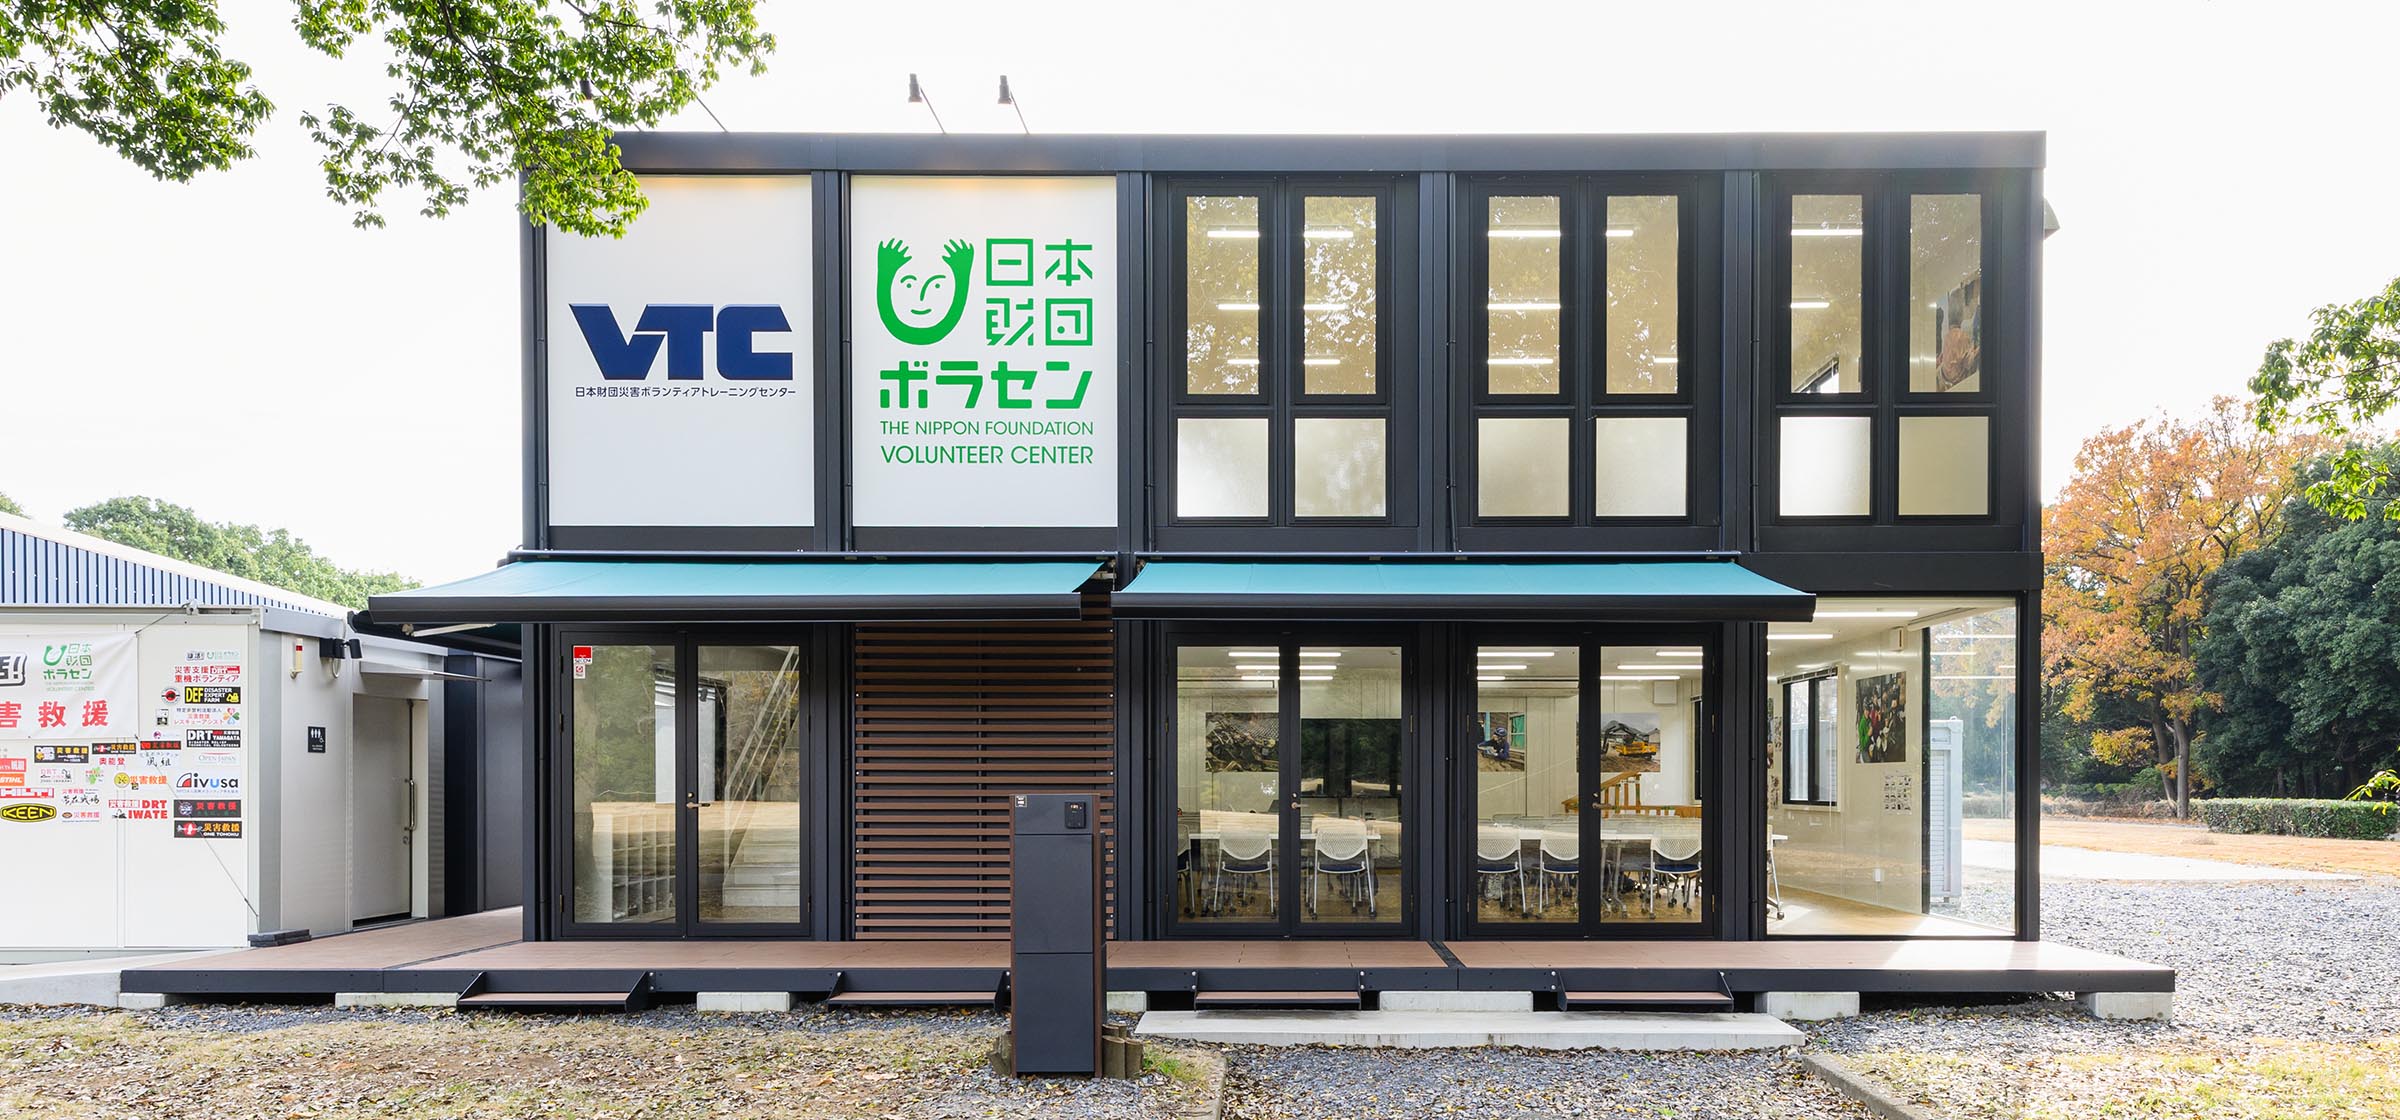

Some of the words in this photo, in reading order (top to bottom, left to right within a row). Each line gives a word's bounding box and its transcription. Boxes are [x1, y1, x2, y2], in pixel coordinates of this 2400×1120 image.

[986, 238, 1093, 287] 日本
[986, 298, 1093, 346] 財団
[568, 303, 793, 380] VTC
[575, 386, 796, 399] 日本財団災害ボランティアトレーニングセンター
[880, 361, 1093, 409] ボラセン
[880, 420, 909, 435] THE
[915, 420, 980, 435] NIPPON
[985, 420, 1093, 435] FOUNDATION
[880, 445, 1003, 464] VOLUNTEER
[1010, 445, 1093, 464] CENTER
[174, 675, 239, 683] 重機ボランティア
[186, 687, 204, 703] DEF
[187, 730, 213, 740] DRT
[193, 773, 238, 788] ivusa
[142, 800, 167, 808] DRT
[3, 806, 53, 820] KEEN
[128, 810, 168, 819] IWATE
